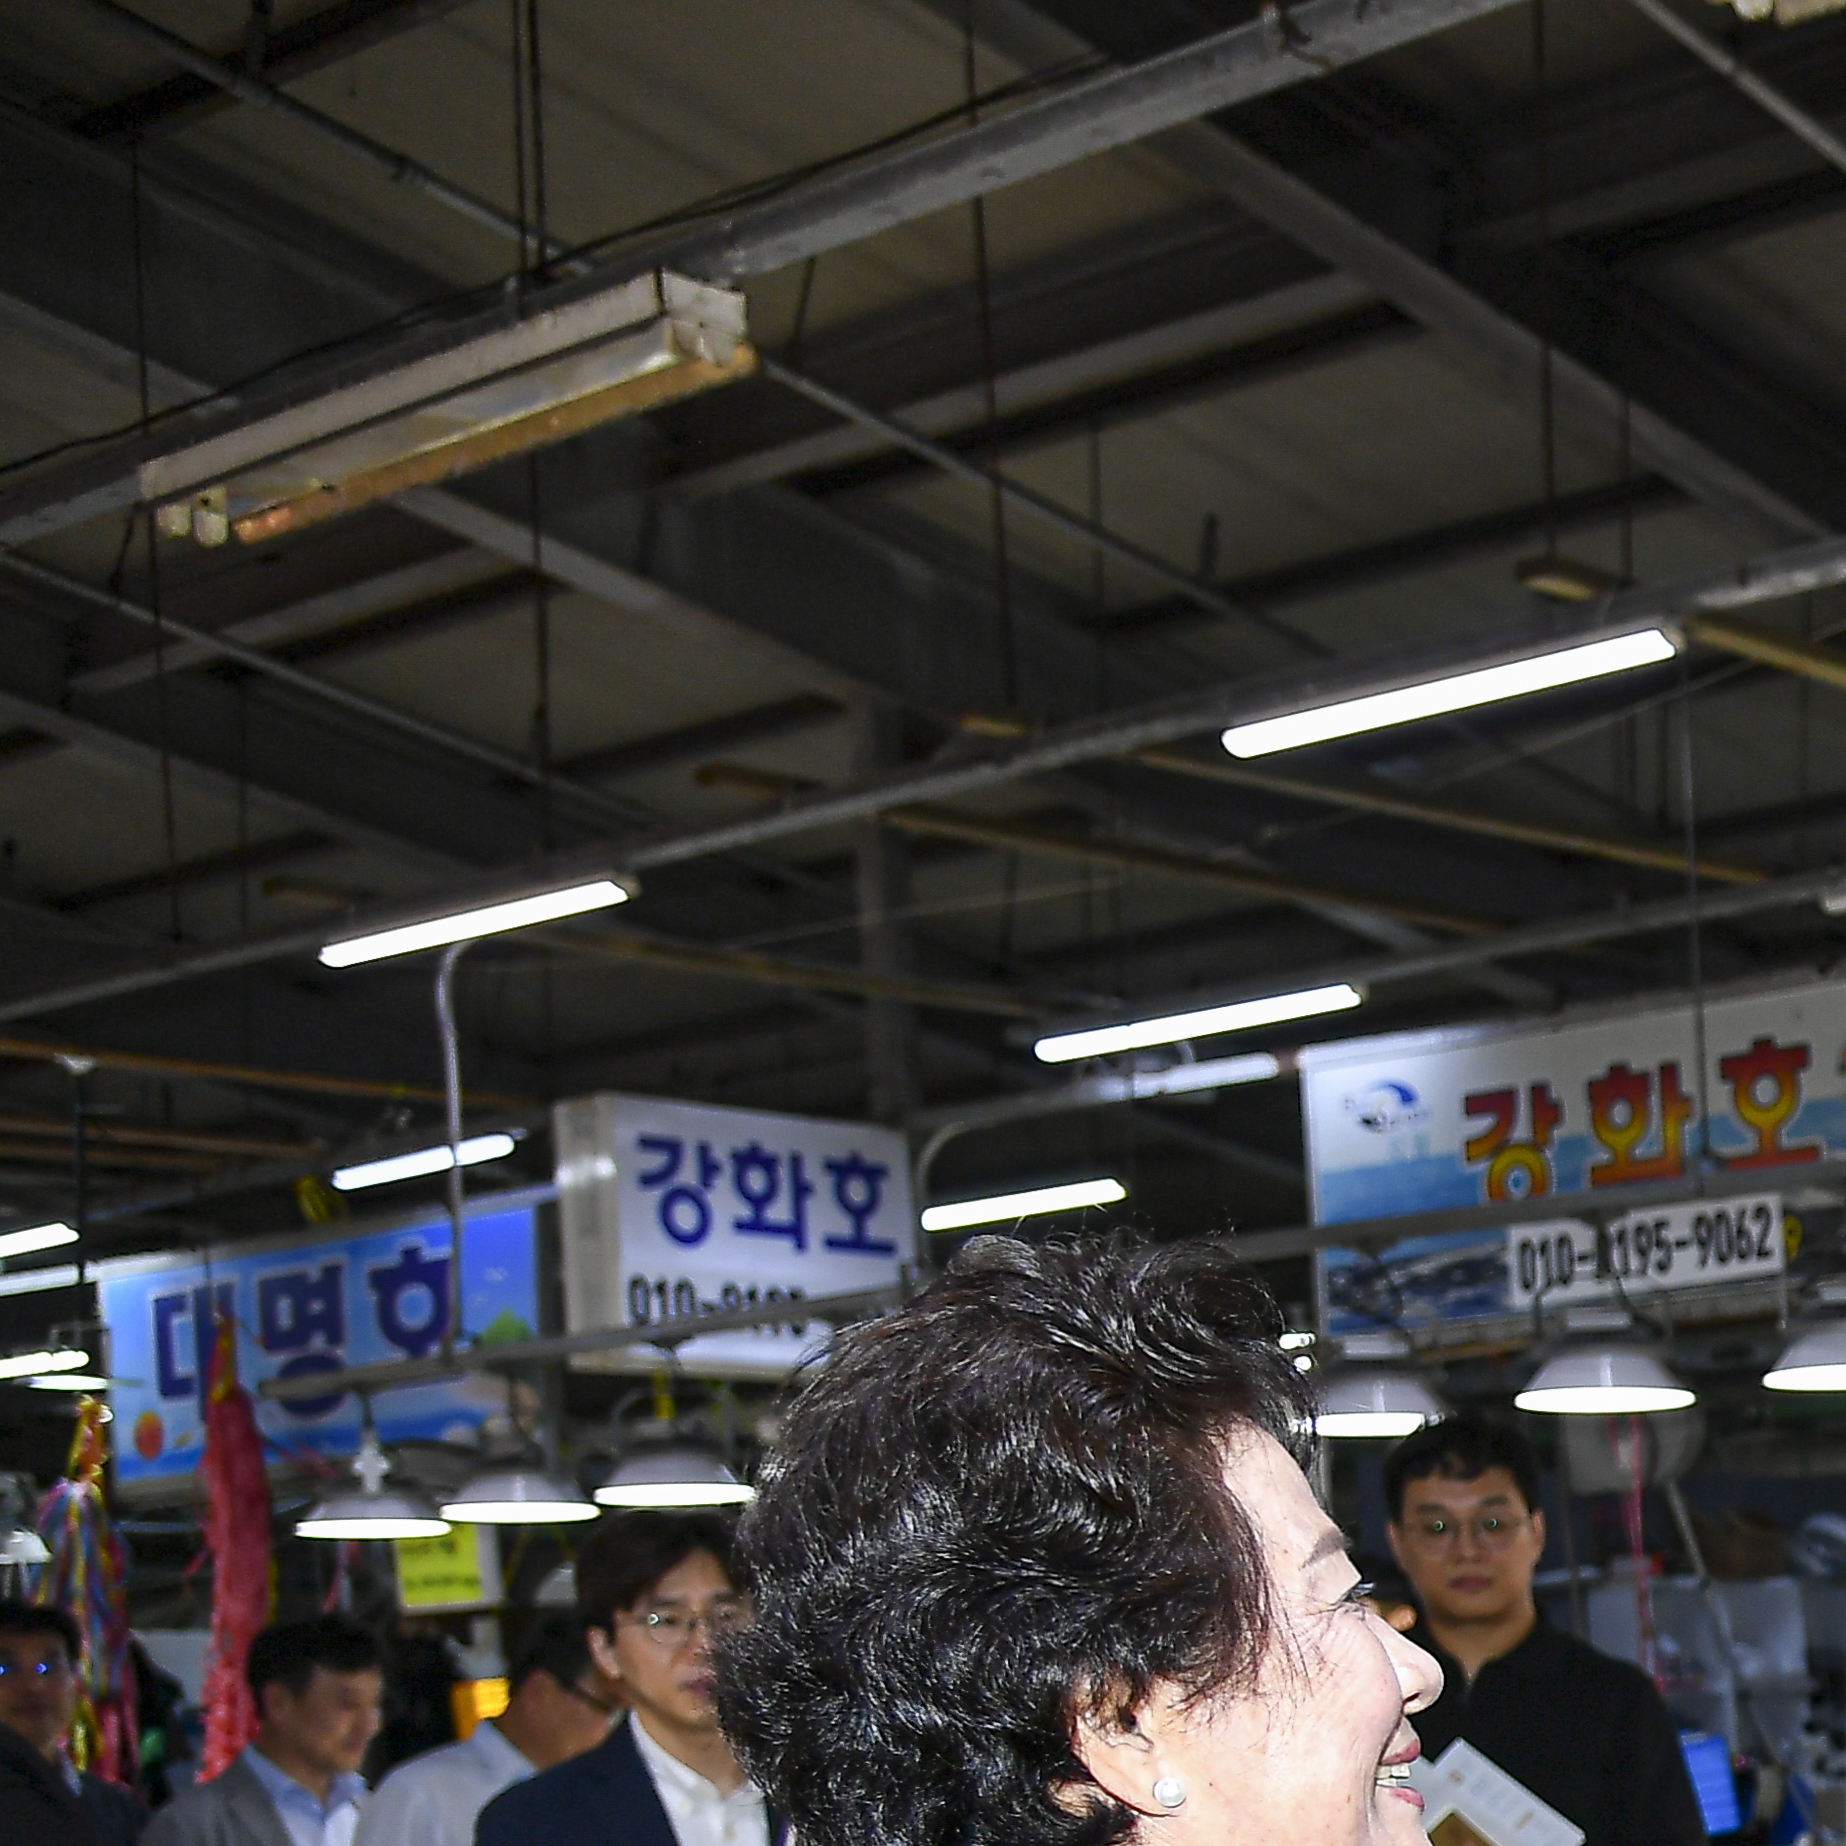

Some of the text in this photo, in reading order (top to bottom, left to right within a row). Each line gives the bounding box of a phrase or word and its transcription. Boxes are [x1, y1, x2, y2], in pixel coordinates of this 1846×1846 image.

[1463, 1037, 1822, 1201] 강화호
[637, 1133, 896, 1256] 강화호
[1519, 1205, 1773, 1290] 010-195-9062
